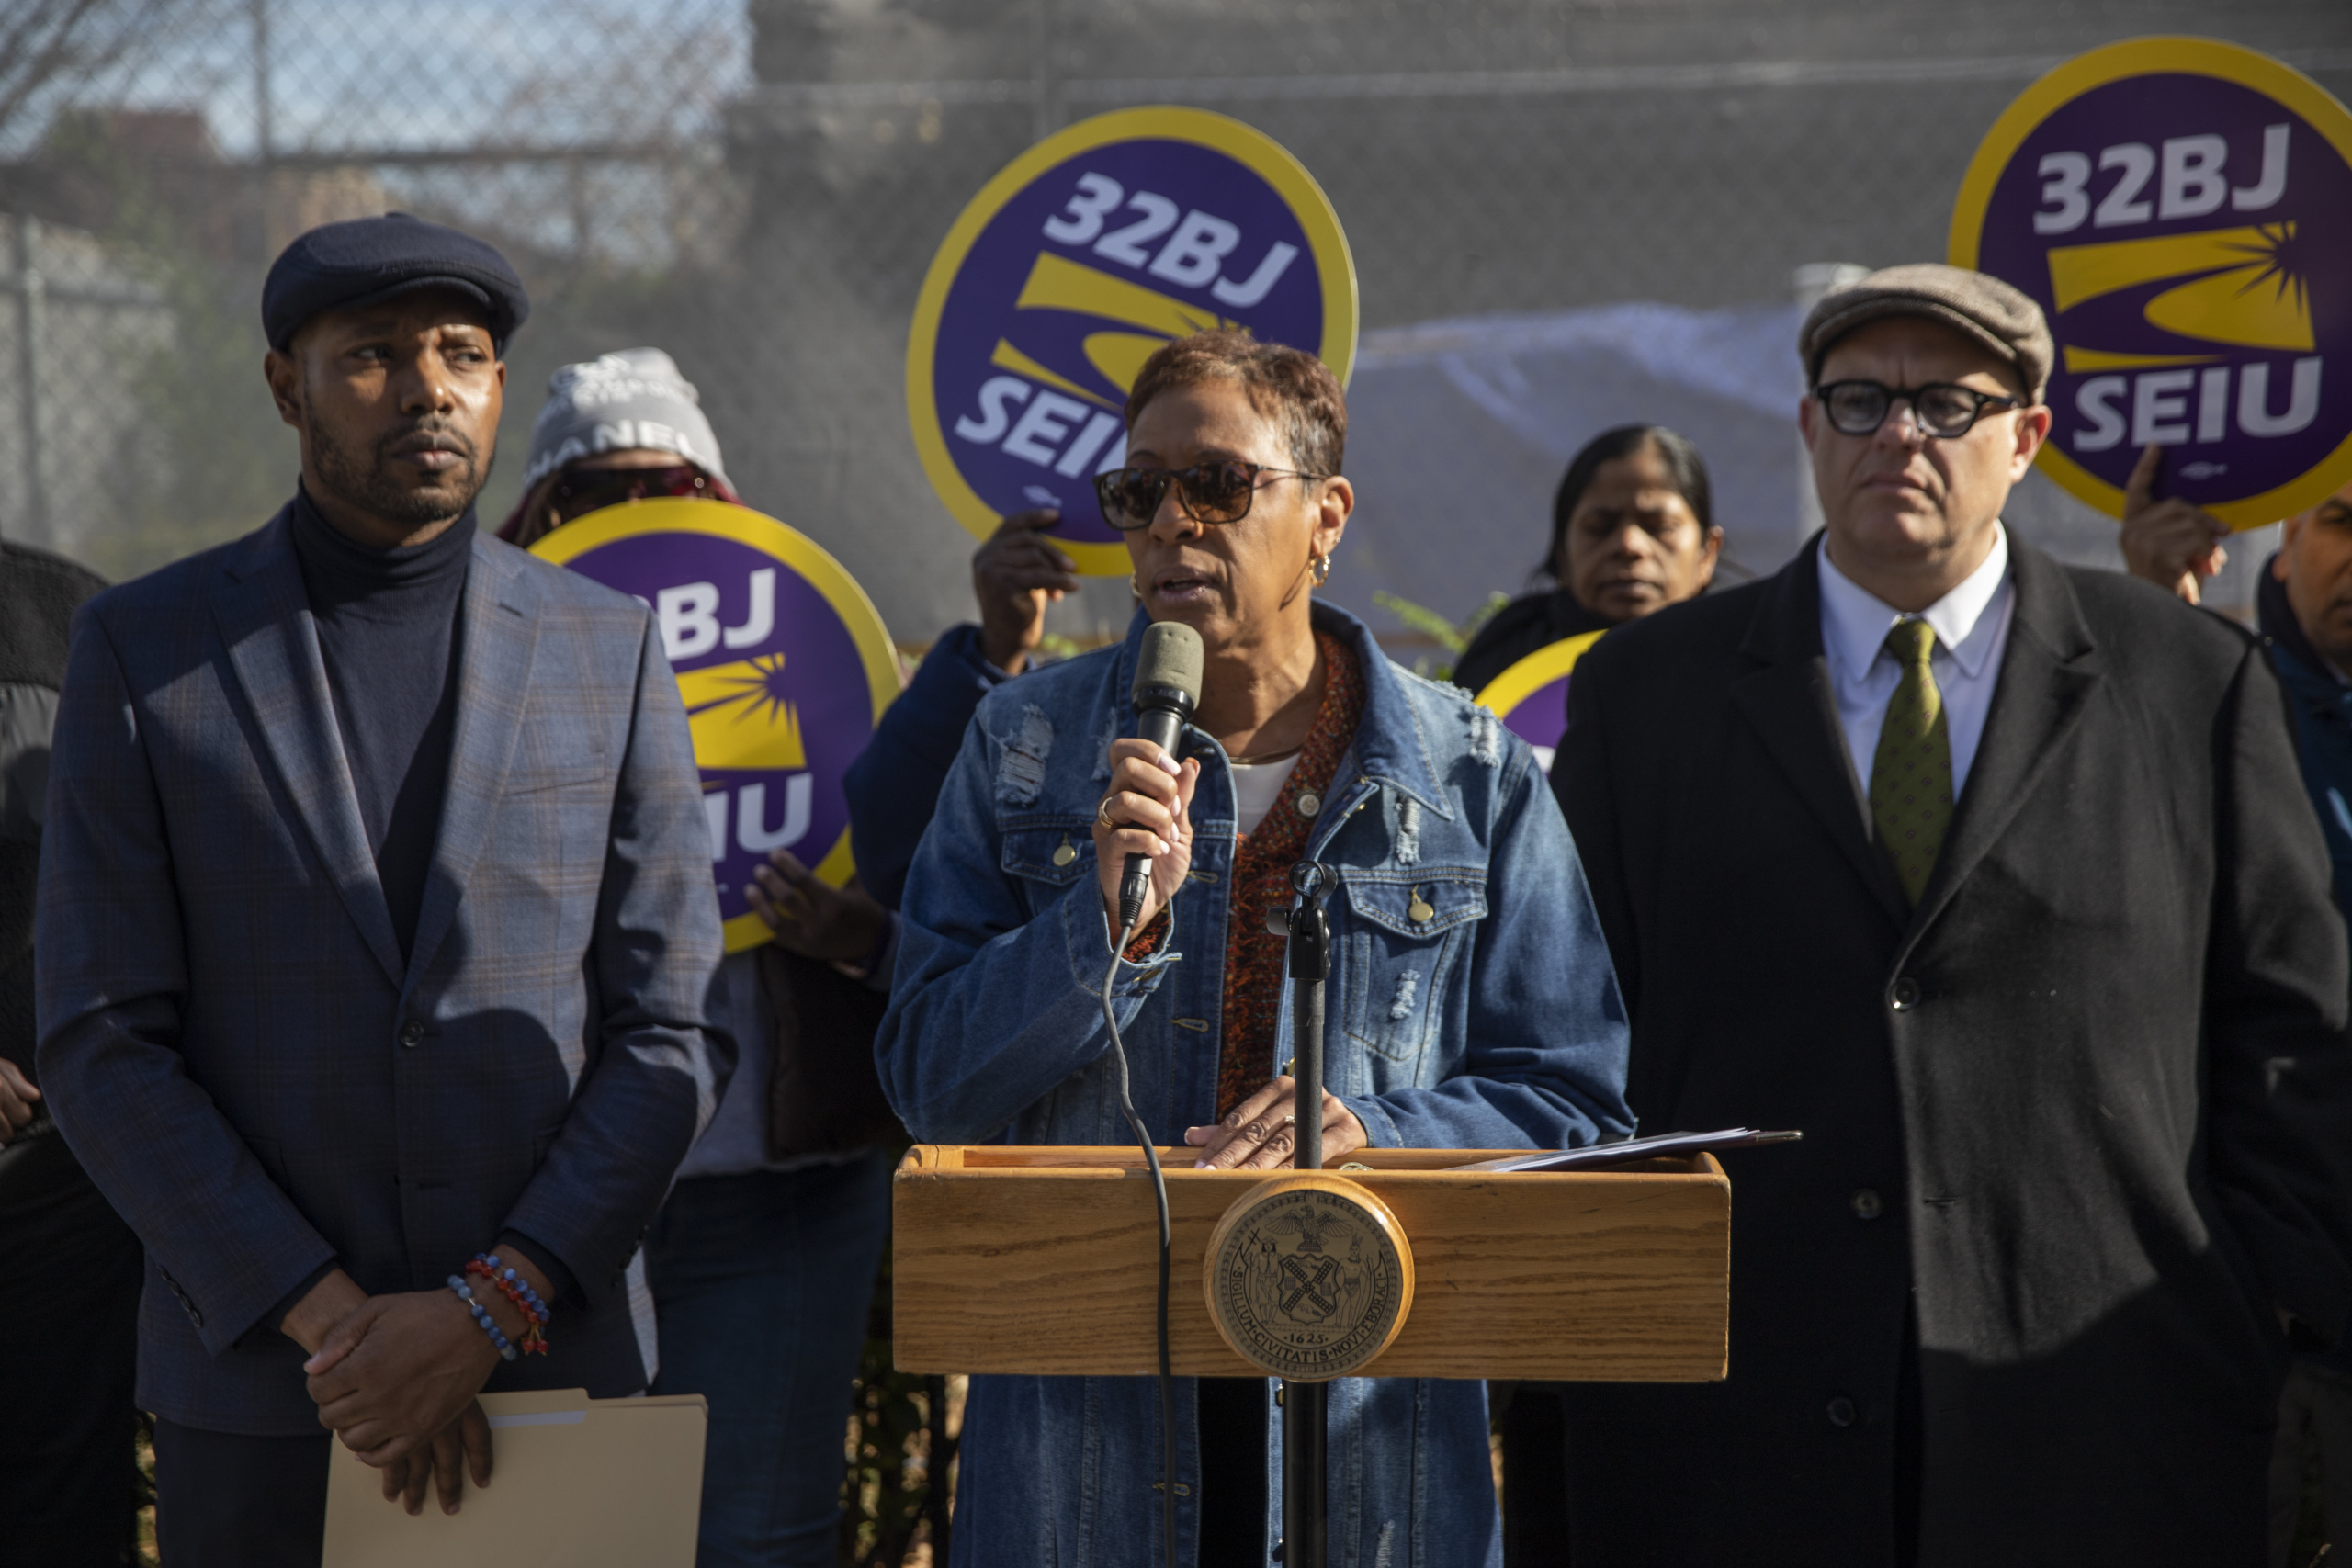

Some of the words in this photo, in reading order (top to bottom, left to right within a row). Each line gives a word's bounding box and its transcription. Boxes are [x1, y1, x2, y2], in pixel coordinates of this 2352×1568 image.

[2032, 121, 2291, 235] 32BJ
[1041, 171, 1300, 308] 32BJ
[954, 375, 1128, 480] SEI
[2072, 355, 2323, 451] SEIU
[631, 566, 775, 662] BJ
